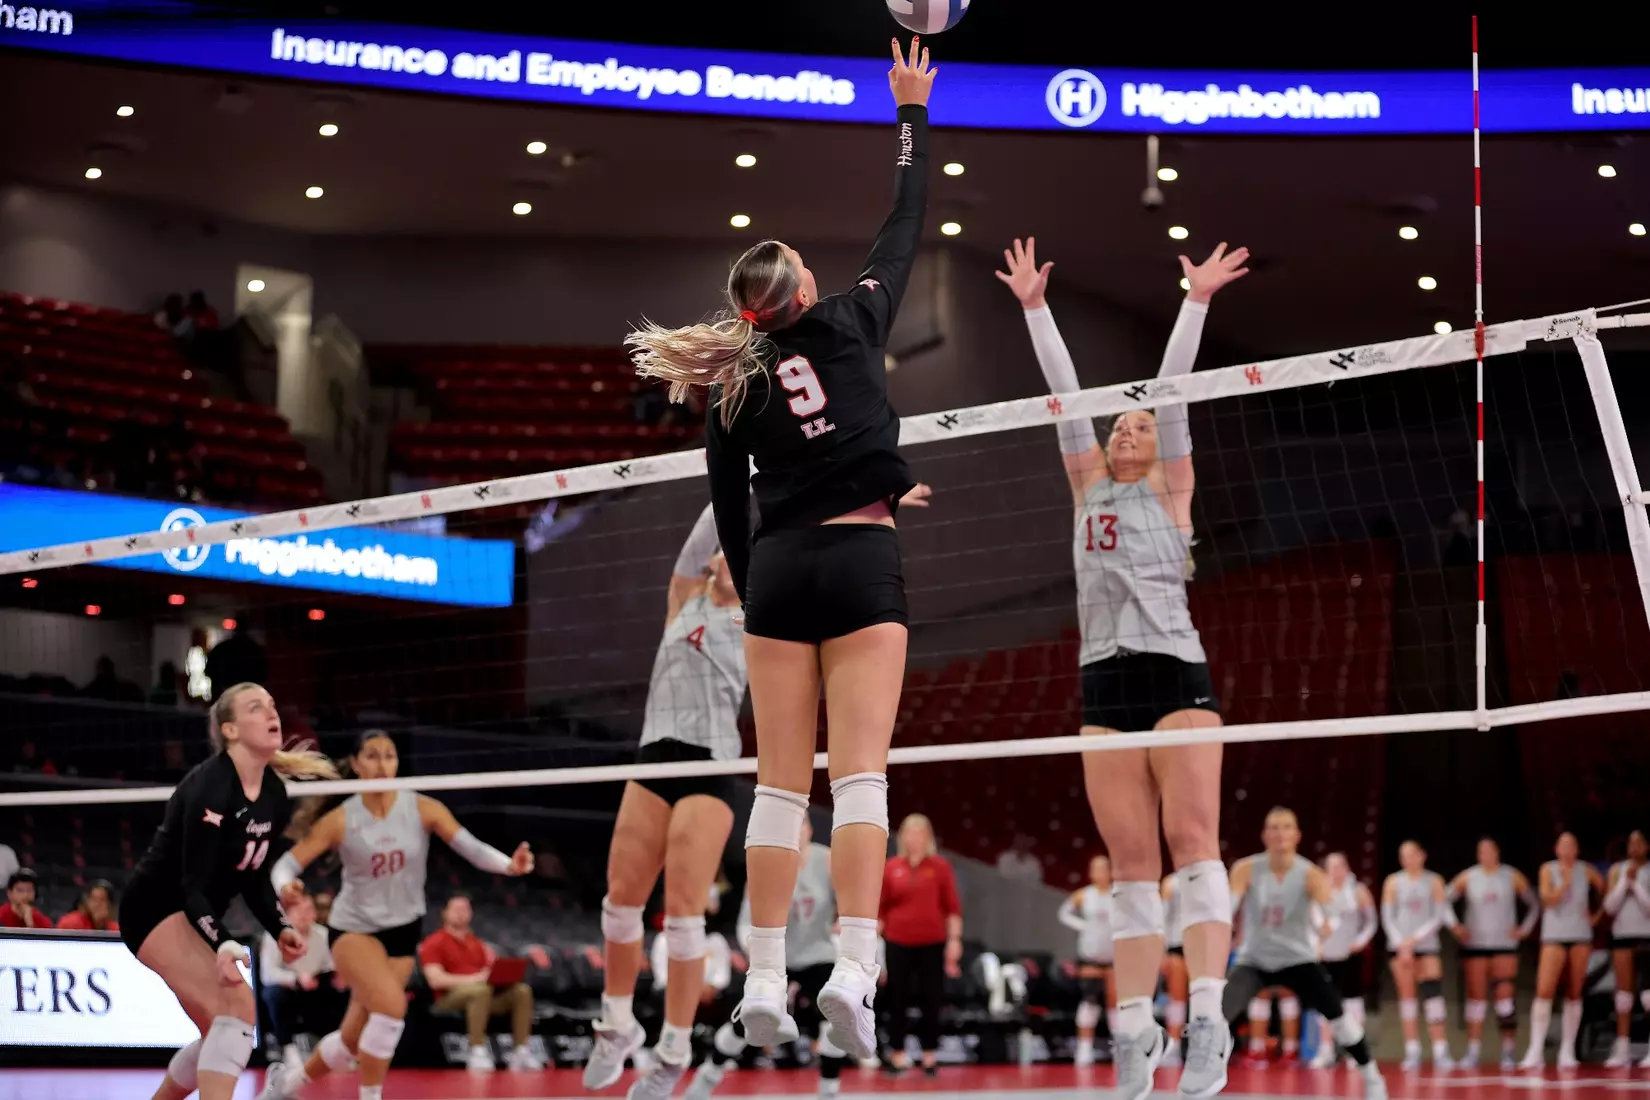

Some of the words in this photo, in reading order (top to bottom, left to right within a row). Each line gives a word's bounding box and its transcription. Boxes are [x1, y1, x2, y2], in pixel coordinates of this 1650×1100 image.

[271, 27, 448, 76] Insurance
[451, 49, 522, 83] and
[526, 52, 702, 100] Employee
[705, 65, 856, 105] Benefits
[1121, 82, 1381, 124] Higginbotham
[897, 122, 913, 166] Houston
[776, 354, 828, 418] 9
[1085, 514, 1118, 552] 13
[686, 625, 705, 651] 4
[371, 849, 406, 879] 20
[0, 965, 112, 1014] ERS
